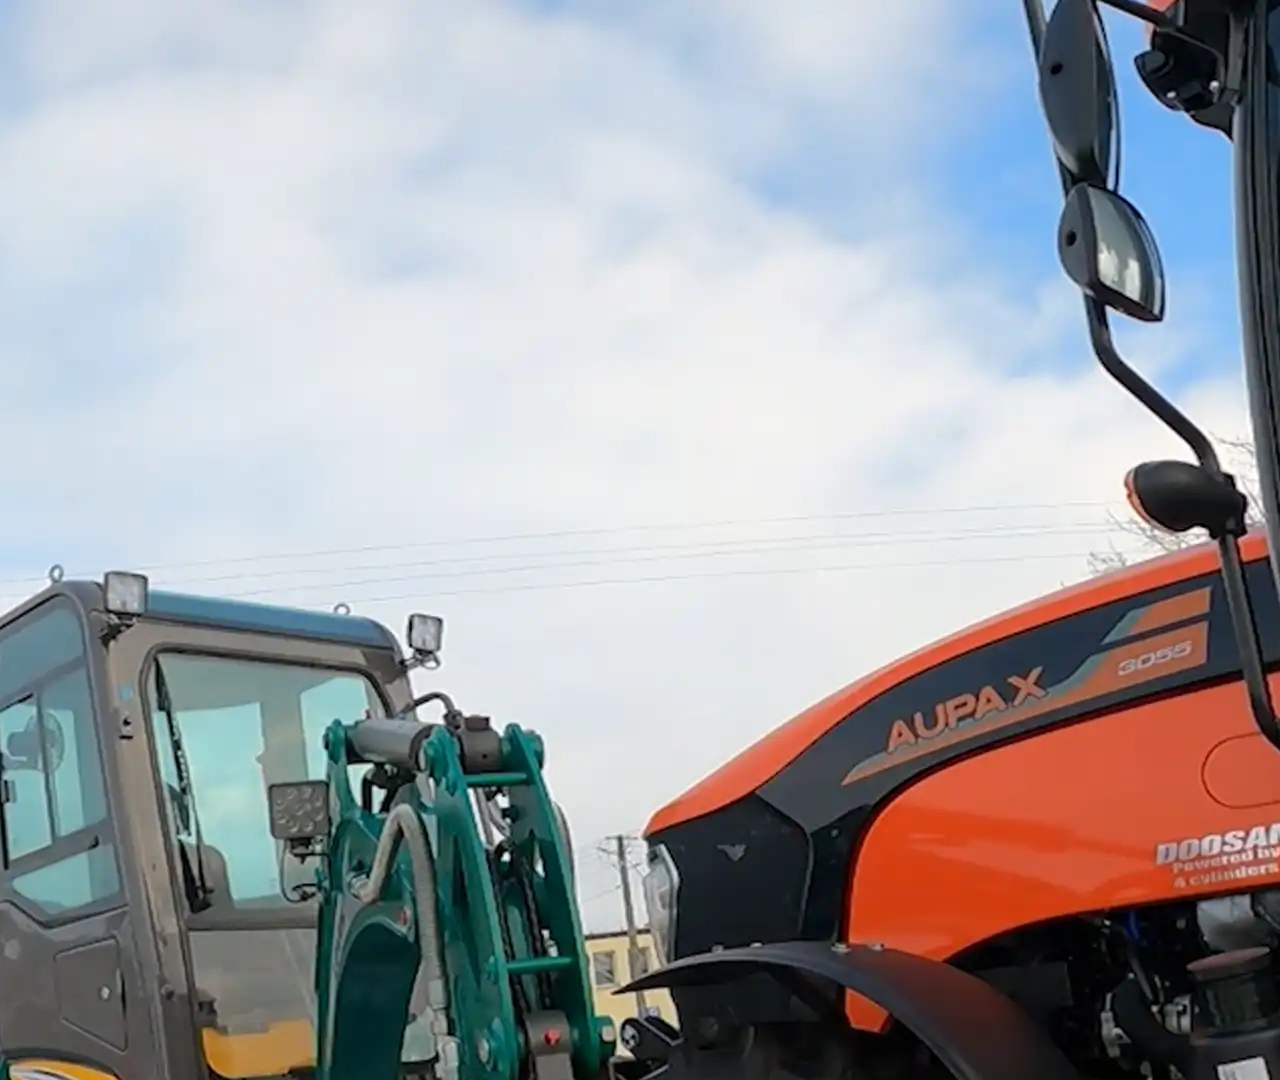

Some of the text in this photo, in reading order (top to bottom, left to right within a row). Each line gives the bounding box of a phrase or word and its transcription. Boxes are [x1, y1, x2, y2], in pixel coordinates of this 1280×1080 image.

[1117, 640, 1192, 676] 3055
[1172, 851, 1254, 873] Powered
[1173, 862, 1280, 888] 4 cylinders
